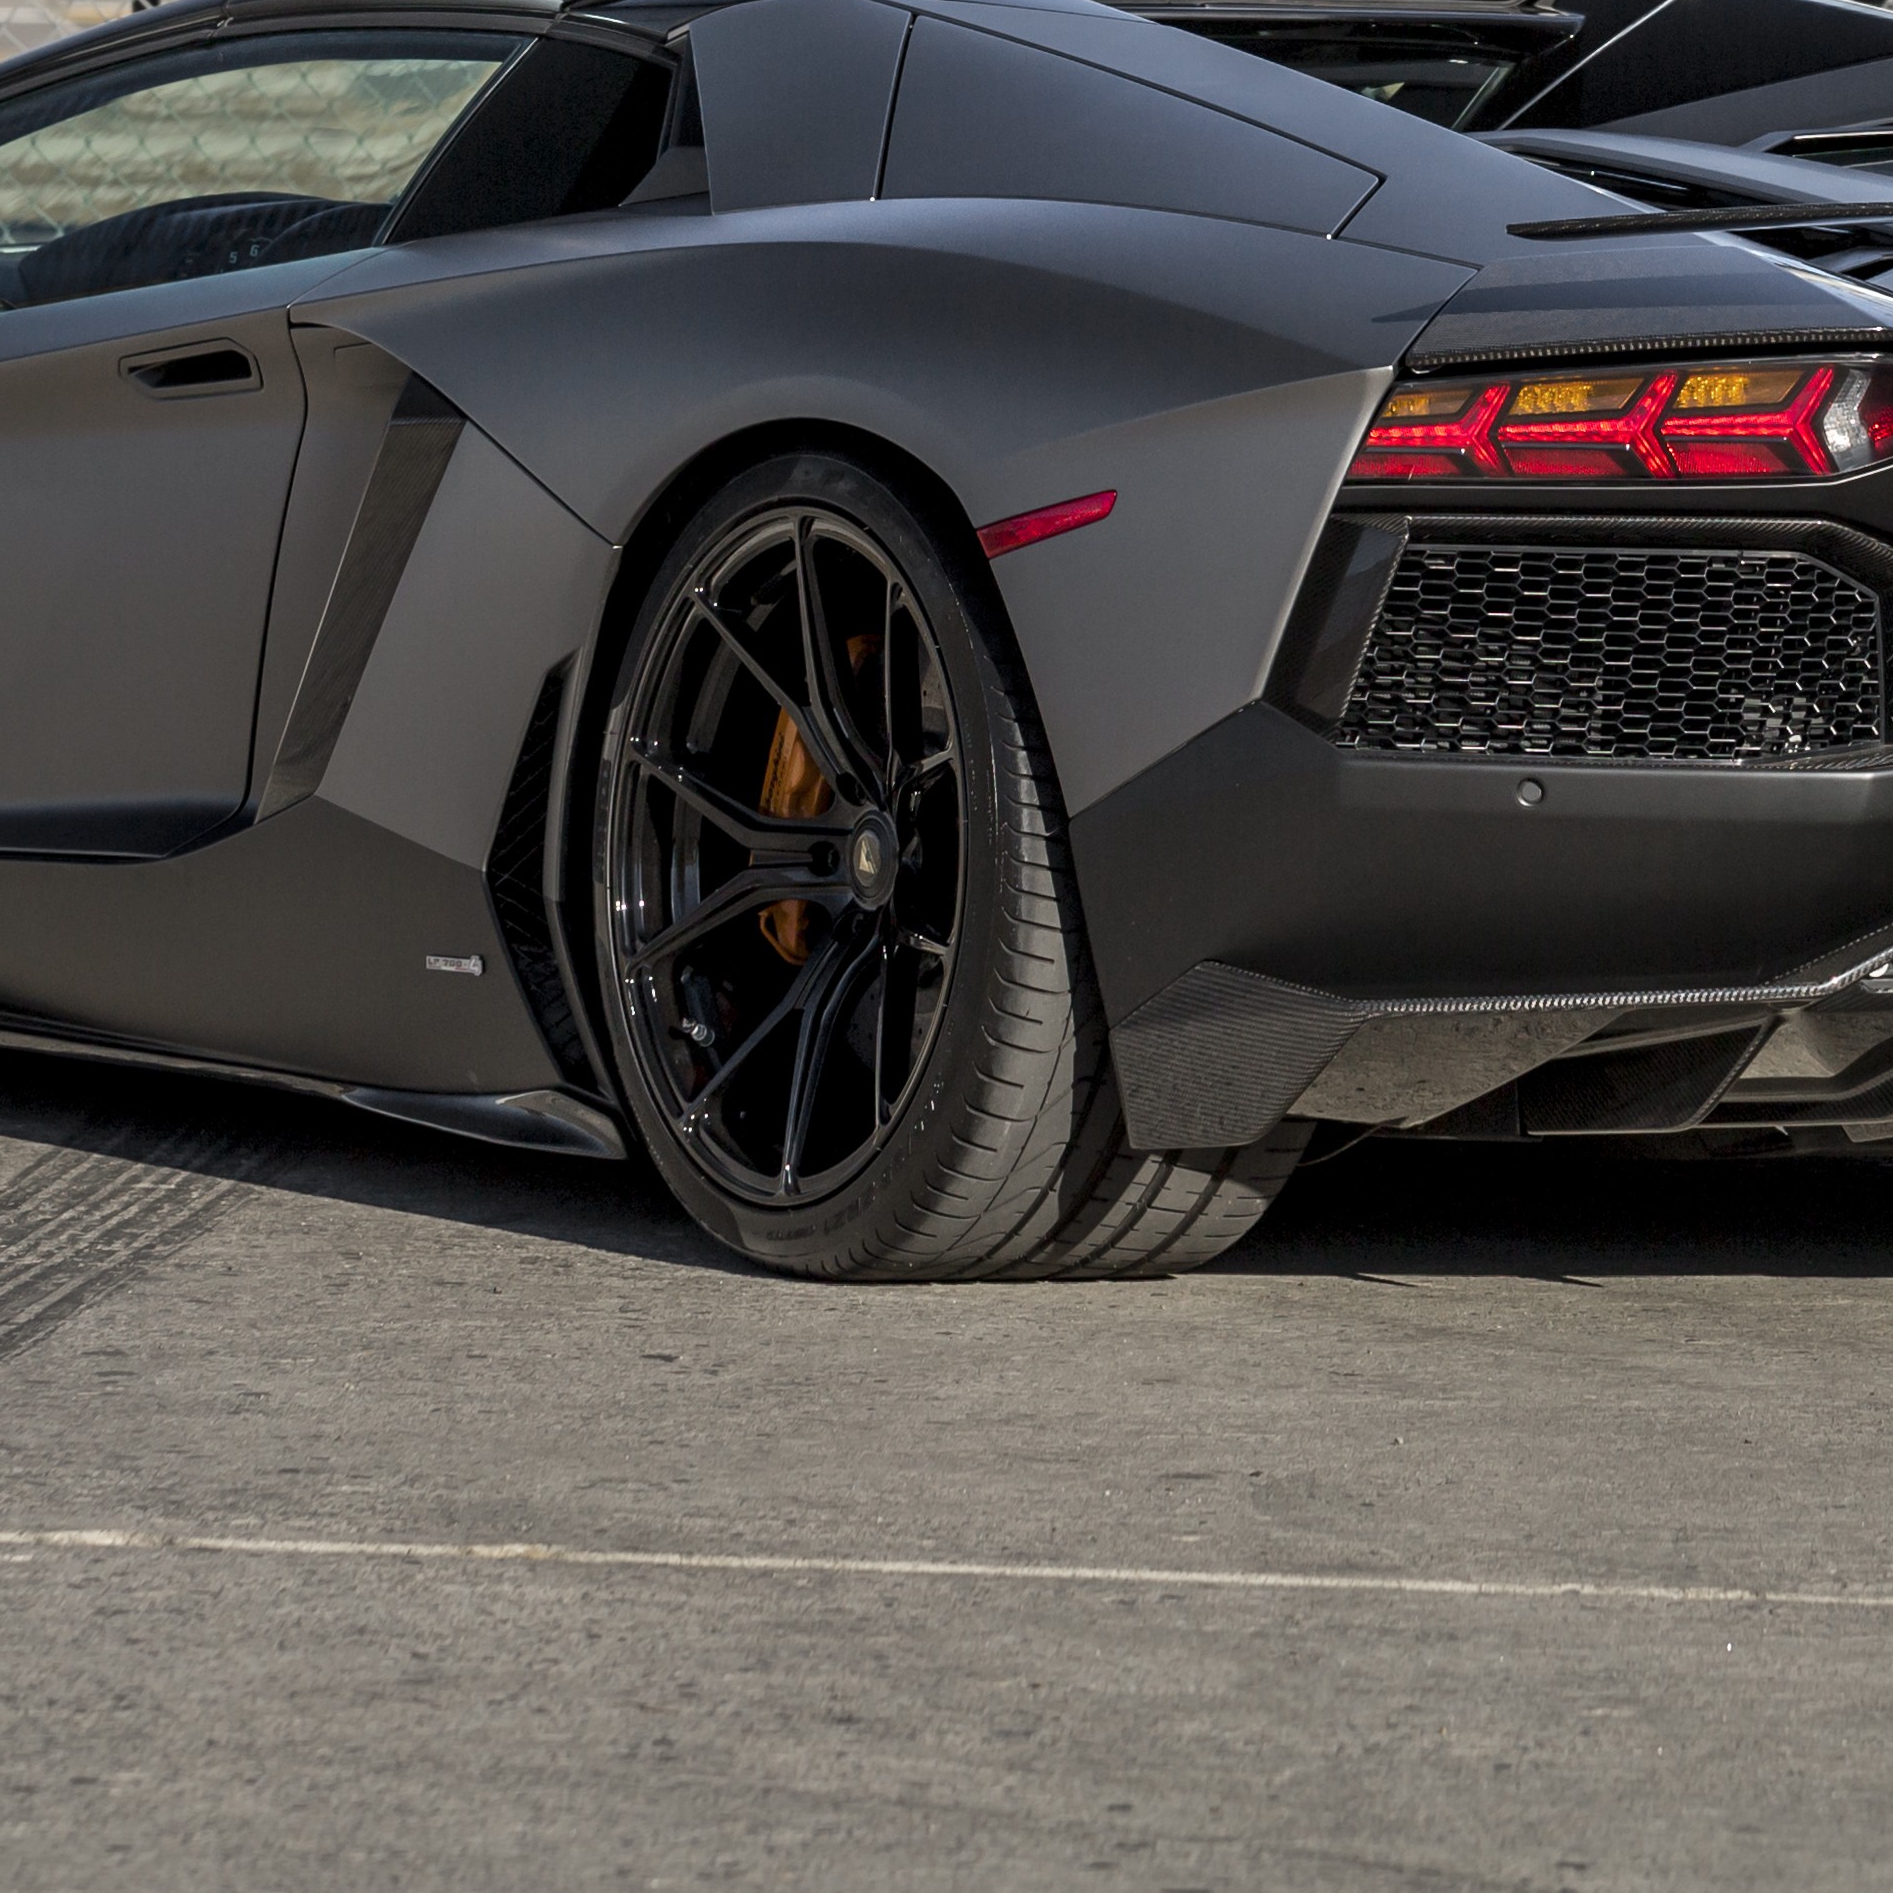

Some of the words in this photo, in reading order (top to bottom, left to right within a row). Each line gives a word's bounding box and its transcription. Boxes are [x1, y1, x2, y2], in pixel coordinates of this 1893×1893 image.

[229, 252, 238, 264] 5
[249, 244, 260, 257] 6
[427, 957, 440, 966] LP
